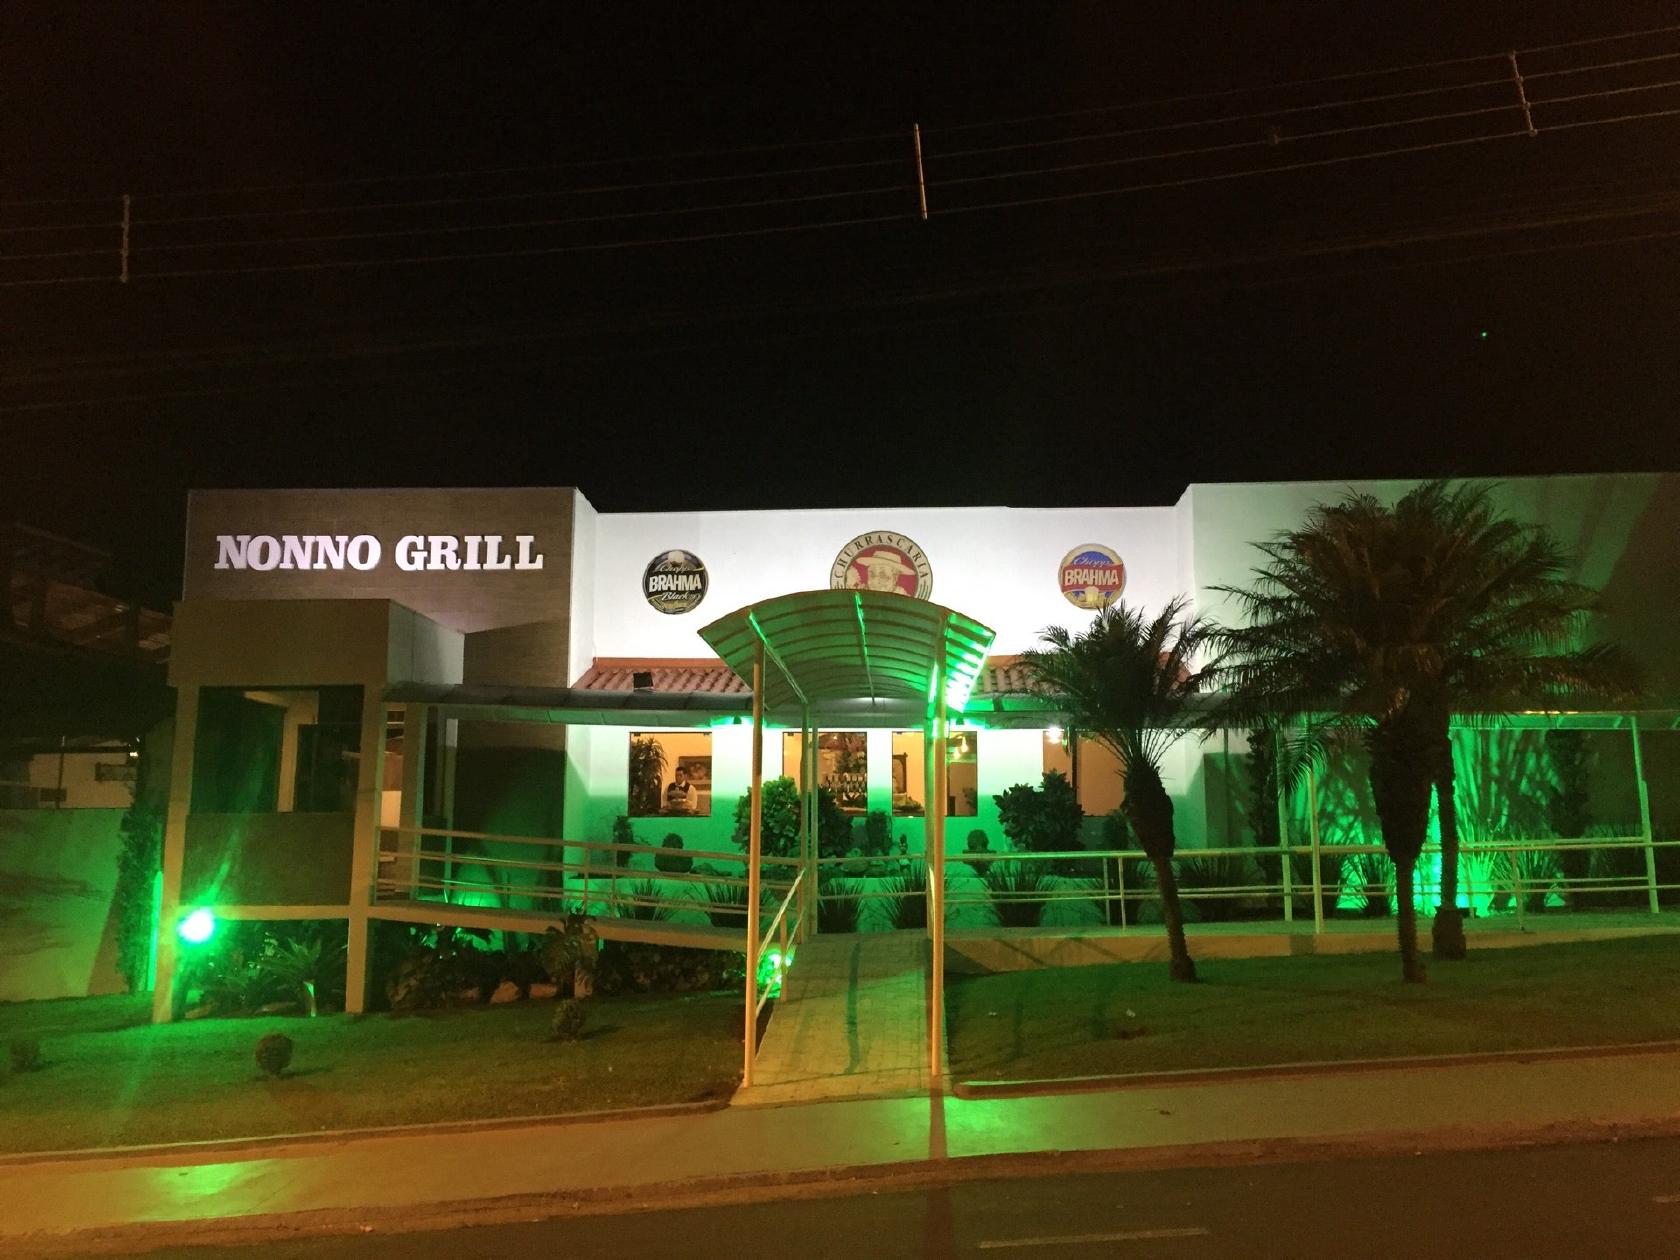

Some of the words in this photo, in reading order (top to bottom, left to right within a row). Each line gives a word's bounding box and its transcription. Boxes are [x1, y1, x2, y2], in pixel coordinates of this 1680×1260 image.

[214, 535, 381, 571] NONNO
[395, 535, 544, 571] GRILL
[834, 534, 929, 578] CHURRASCARIA
[649, 574, 702, 593] BRAHMA
[1064, 568, 1119, 587] BRAHMA
